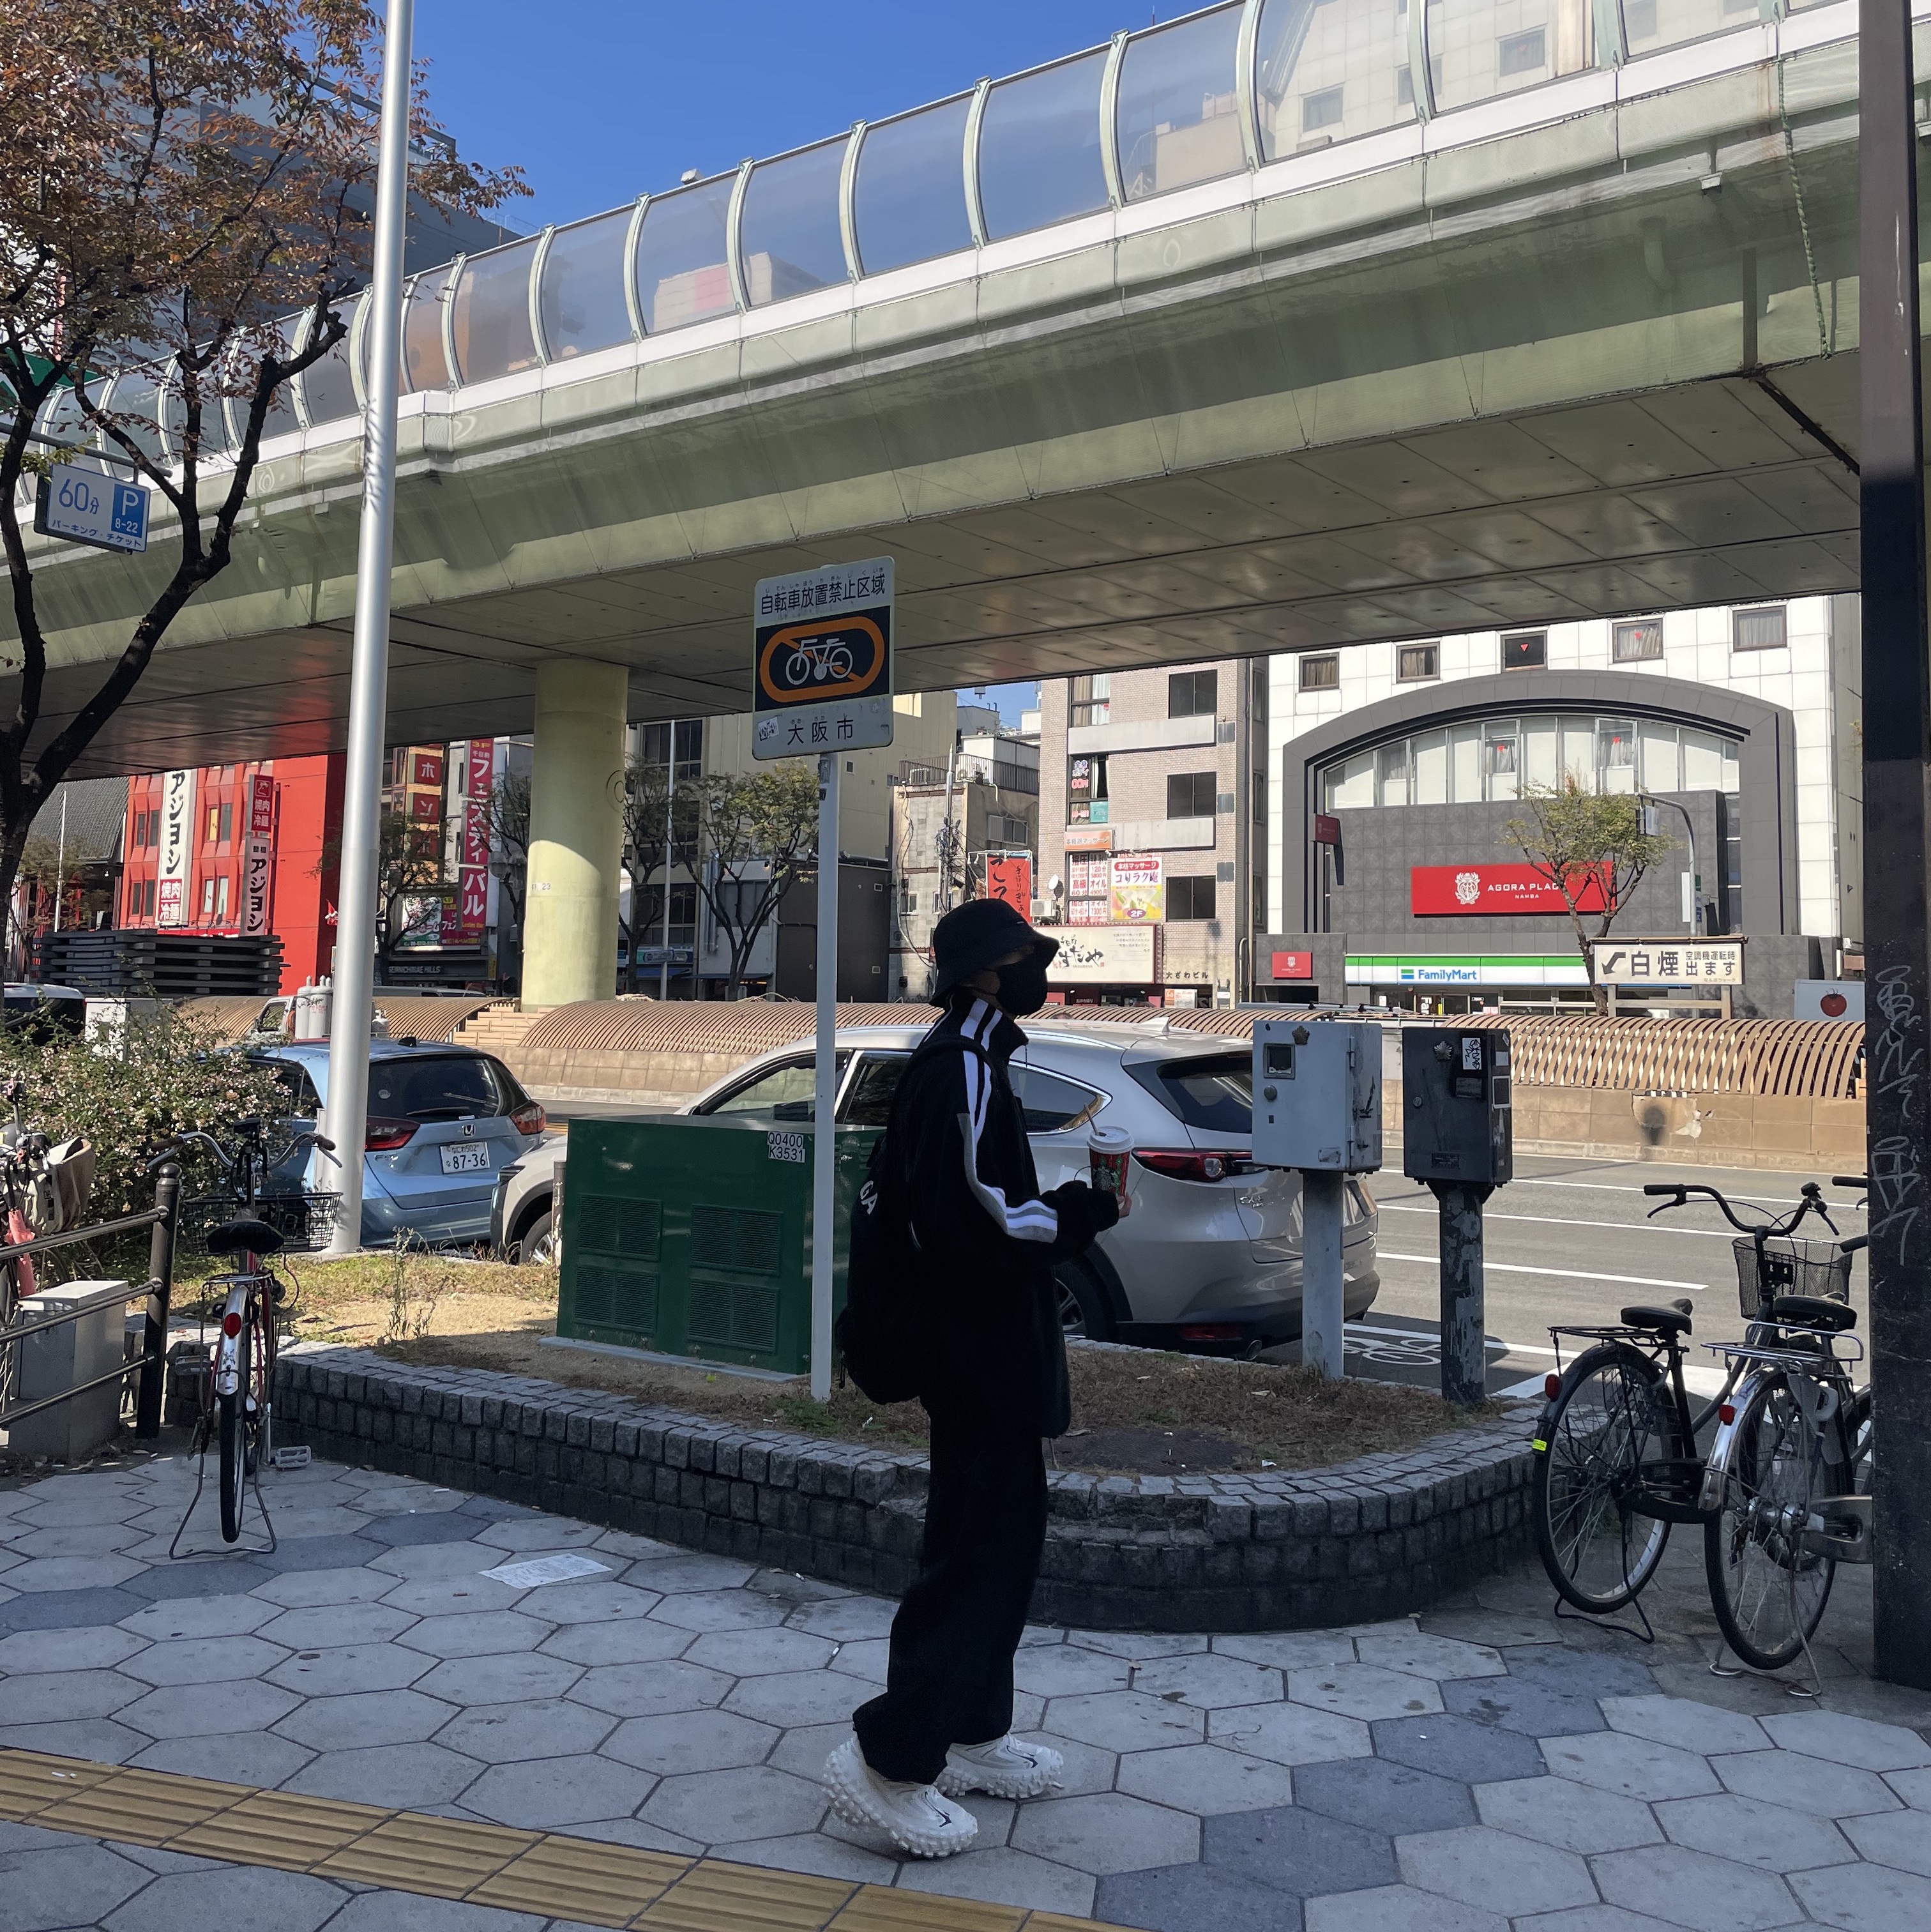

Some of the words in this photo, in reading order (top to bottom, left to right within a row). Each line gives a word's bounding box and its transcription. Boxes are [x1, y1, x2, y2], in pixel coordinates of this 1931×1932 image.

[58, 478, 100, 515] 60分
[121, 489, 139, 517] P
[52, 519, 141, 547] パーキング・チケット
[114, 517, 138, 534] 8-22
[761, 573, 886, 615] 自転車放置禁止区域
[787, 717, 854, 746] 大阪市
[254, 798, 270, 812] 焼肉
[160, 881, 181, 899] 焼肉
[1015, 865, 1026, 915] 手作りぎょ
[1090, 879, 1107, 889] オイル
[1487, 883, 1526, 892] AGORA
[1529, 882, 1560, 891] PLAC
[1630, 950, 1679, 977] 白煙
[1685, 950, 1736, 961] 空調機運転時
[1418, 969, 1477, 981] FamilyMart
[1685, 961, 1736, 977] 出ます
[768, 1132, 803, 1148] Q0400
[453, 1153, 486, 1169] 87-36
[769, 1146, 803, 1162] K3531
